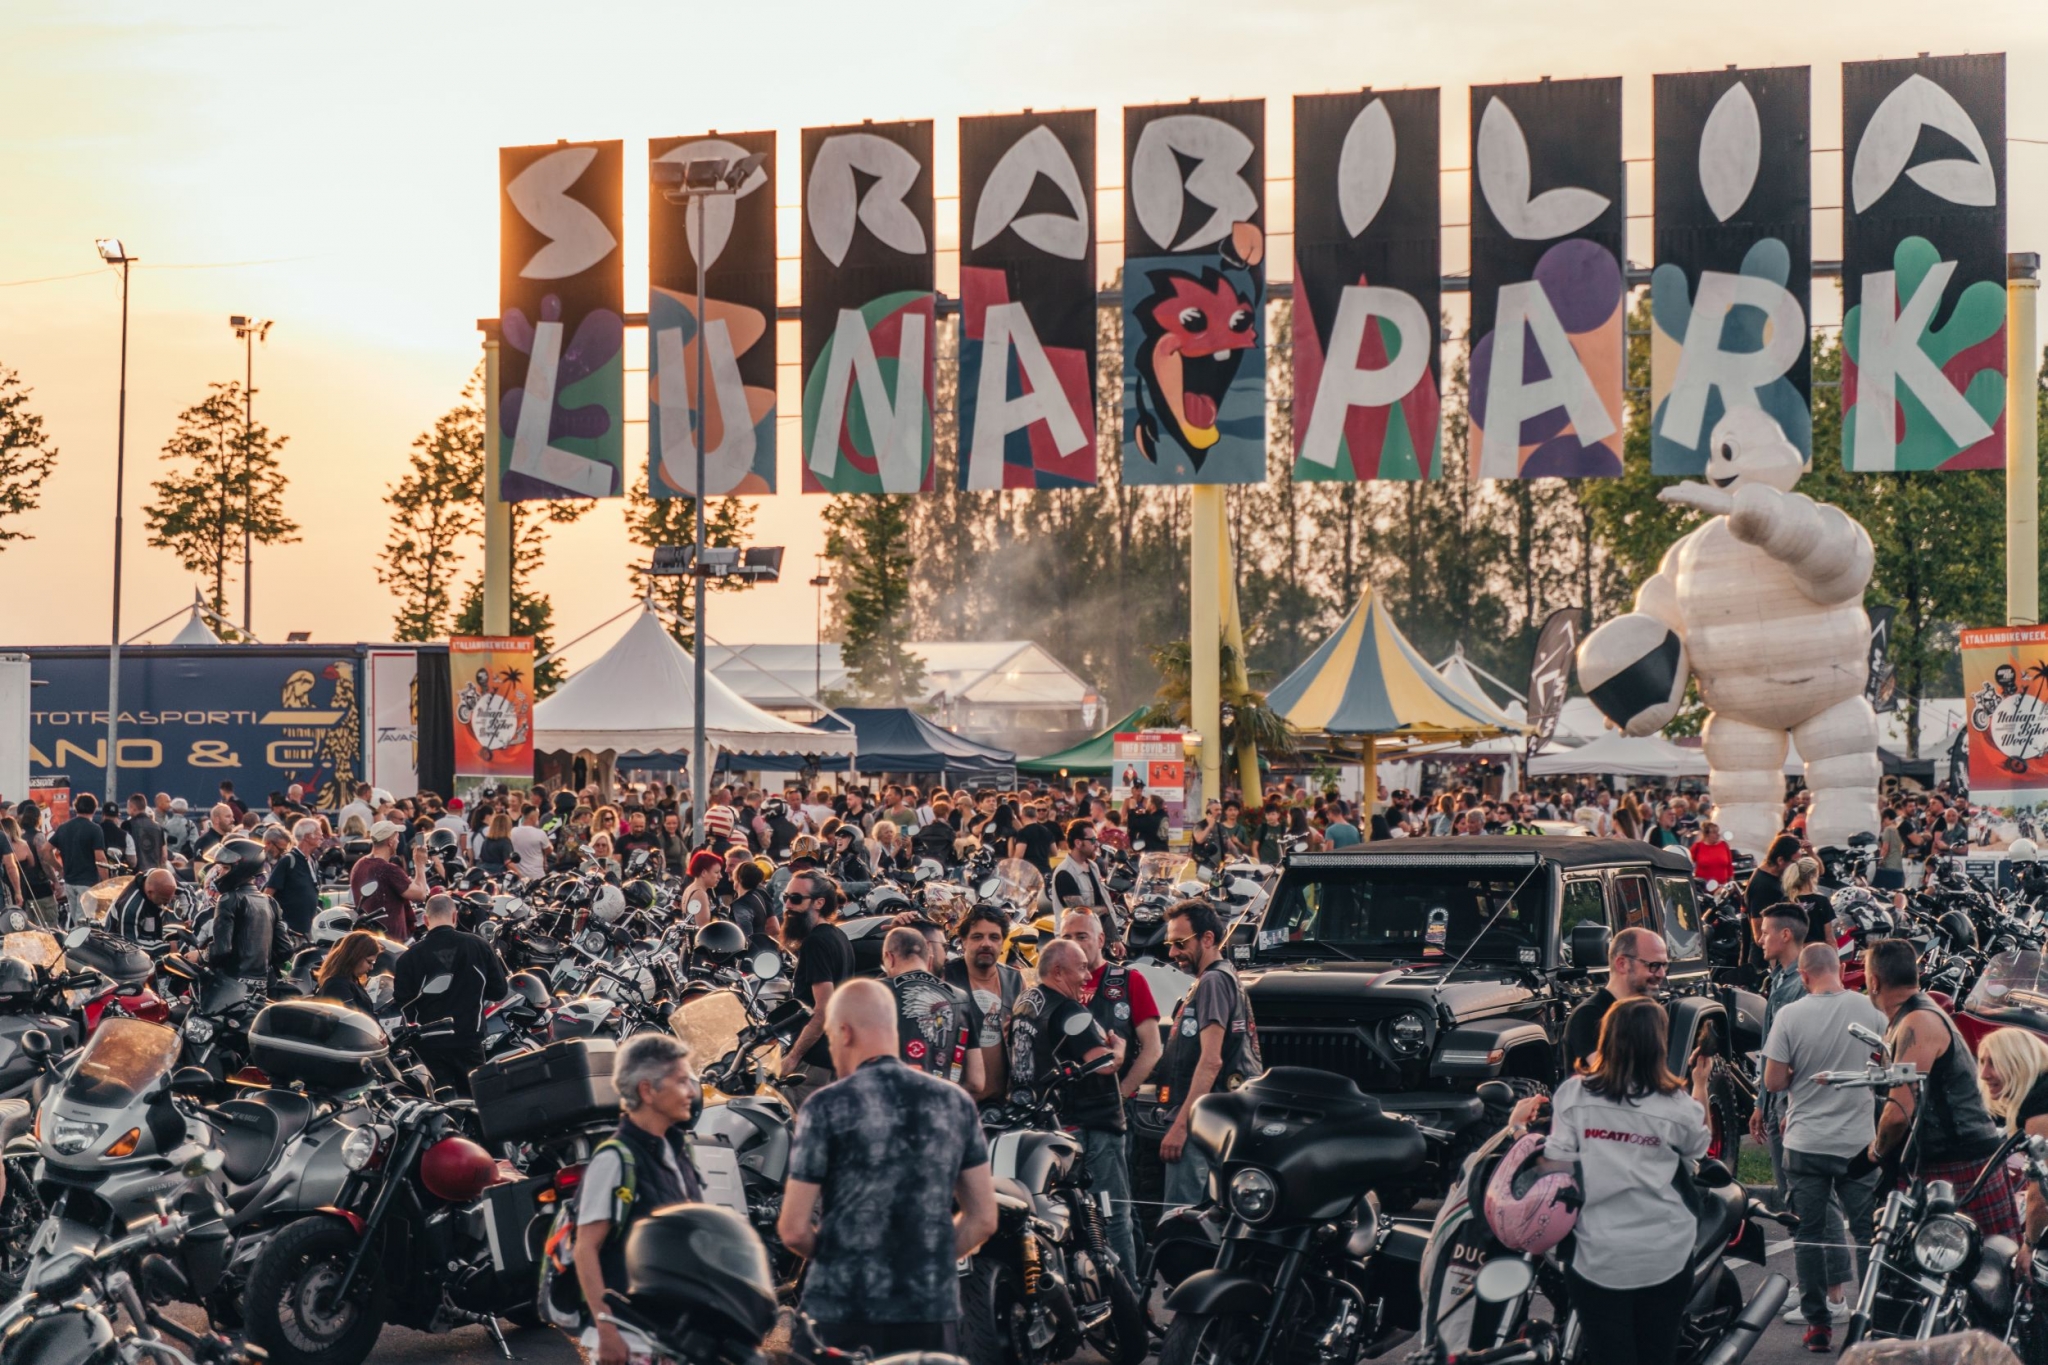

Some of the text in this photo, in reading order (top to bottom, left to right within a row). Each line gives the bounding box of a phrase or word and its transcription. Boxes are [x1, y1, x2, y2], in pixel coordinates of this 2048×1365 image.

[506, 72, 1996, 280] STRABILIA
[507, 260, 1993, 498] LUNA PARK
[1997, 710, 2035, 723] Italian
[2001, 733, 2034, 746] Week
[187, 740, 242, 768] &
[1122, 743, 1176, 753] INFO COVID-19
[146, 1179, 181, 1193] HONDA
